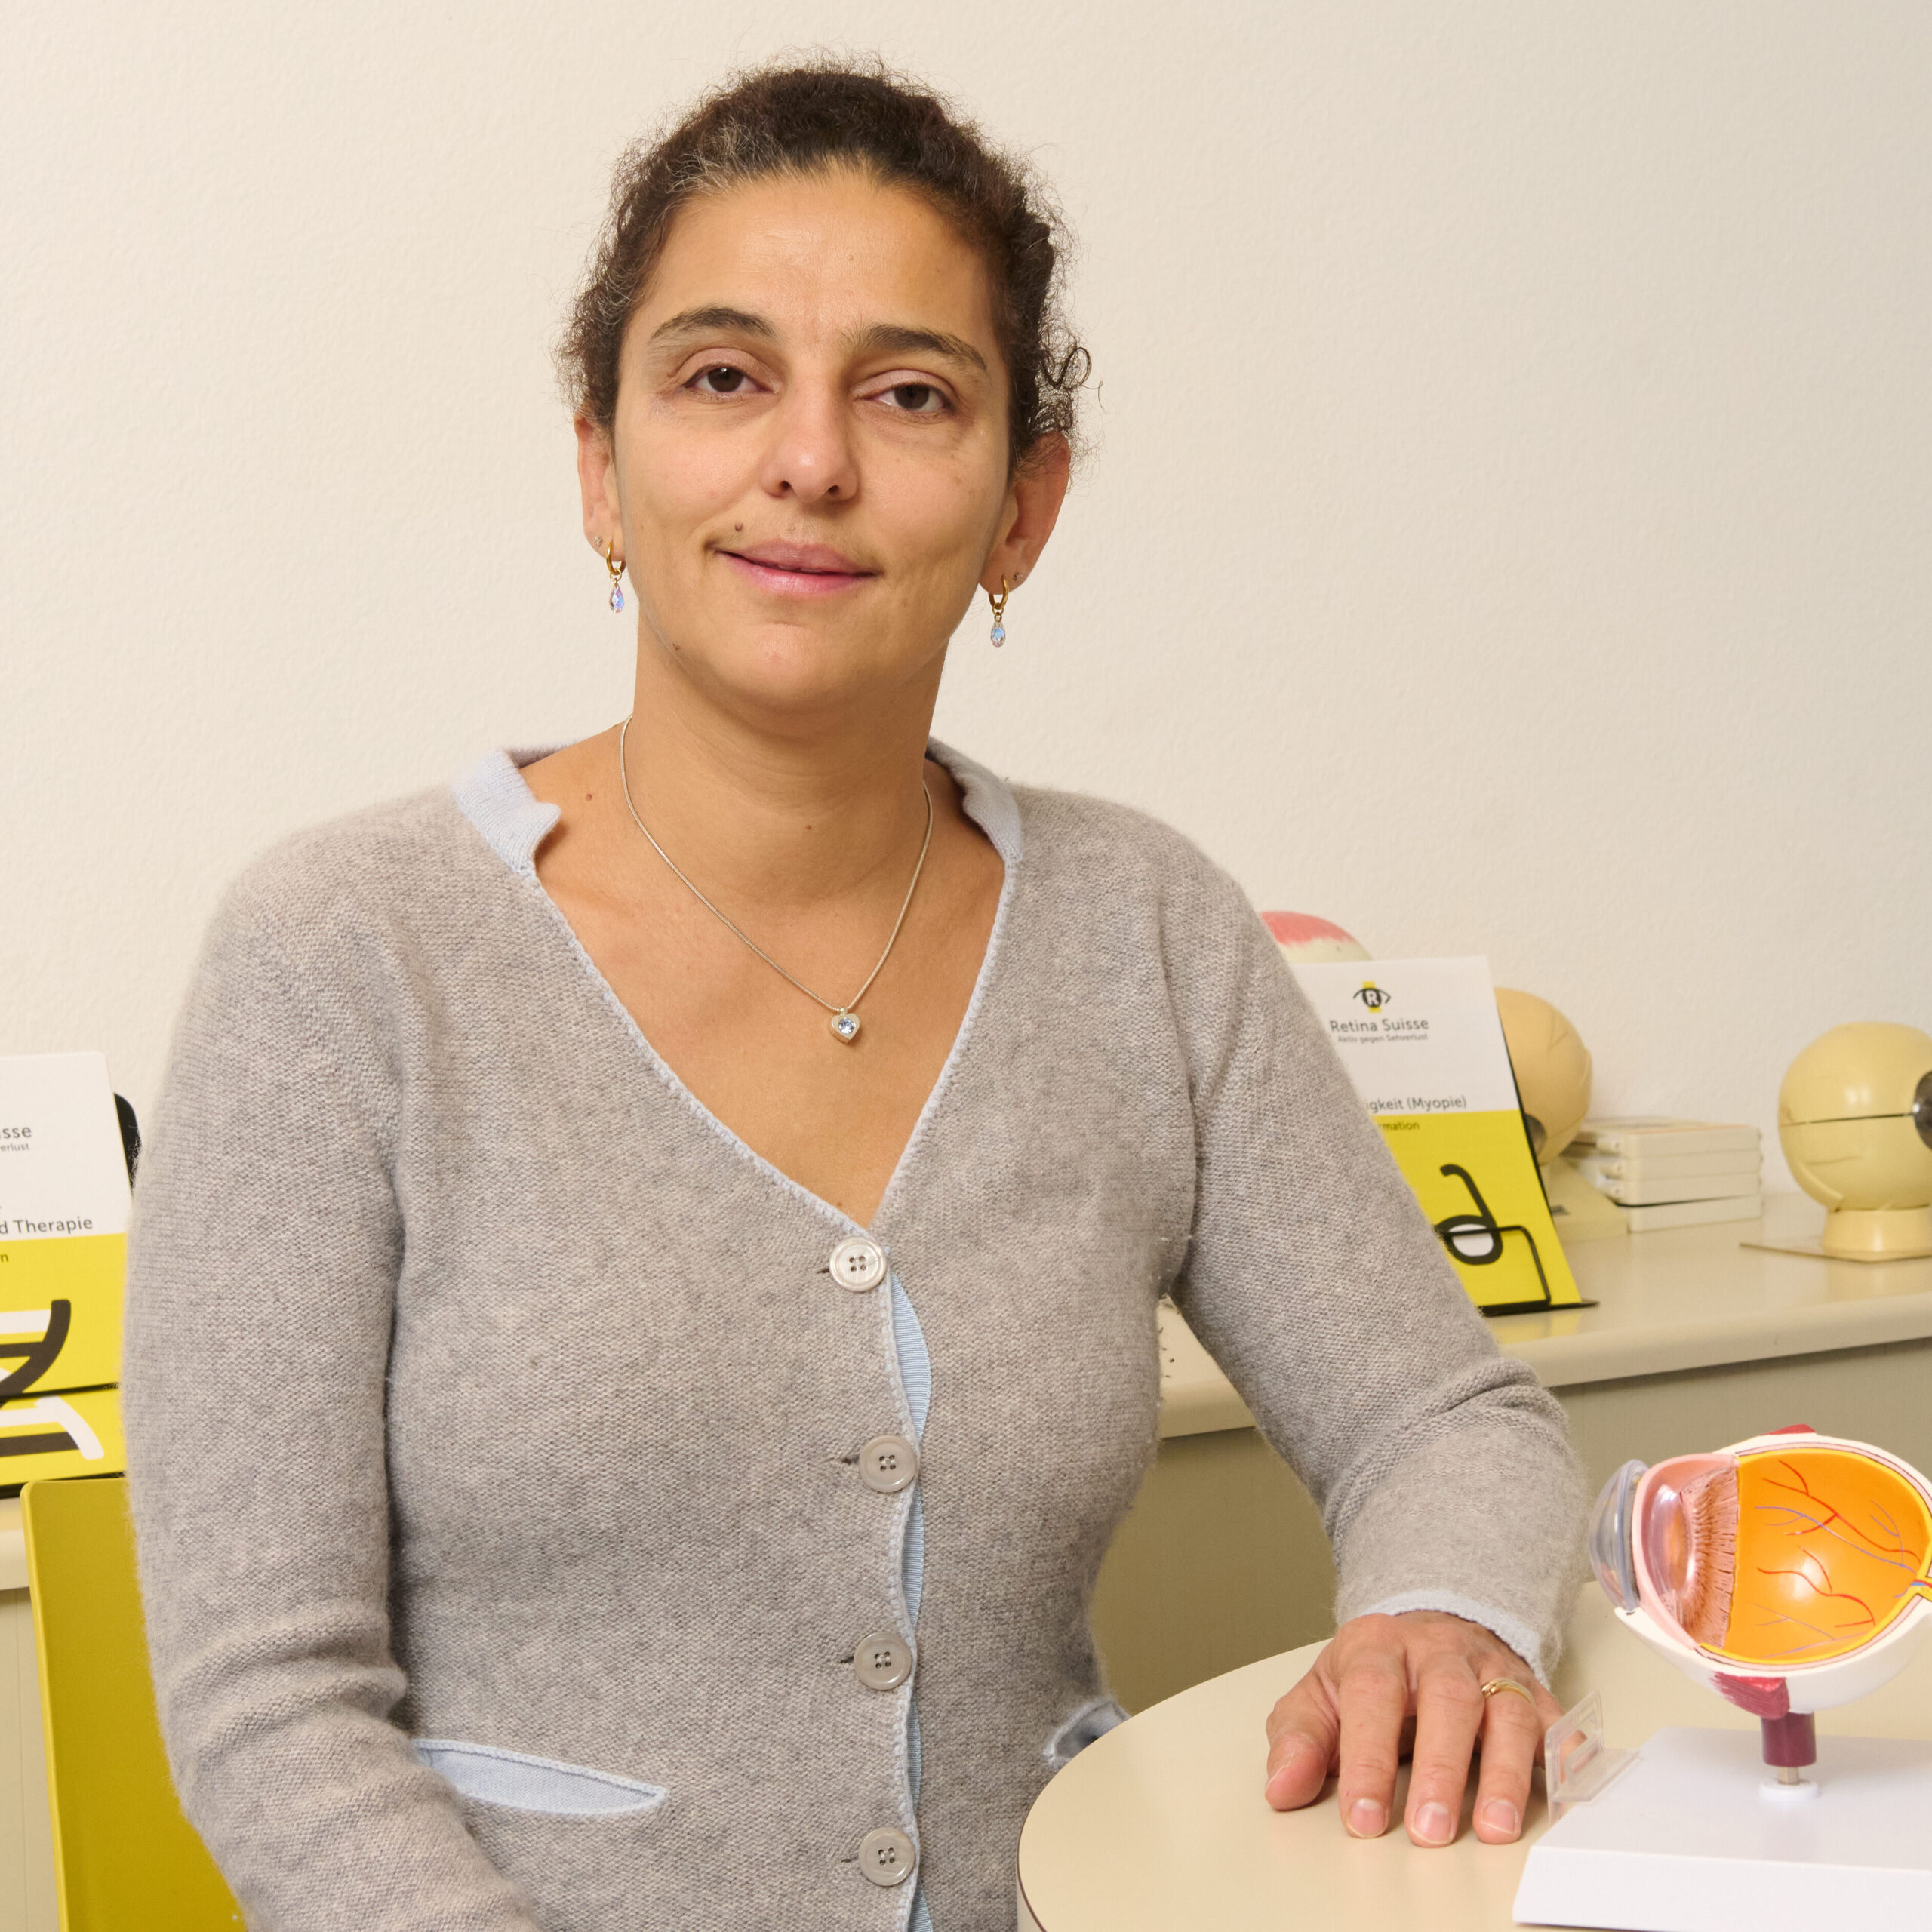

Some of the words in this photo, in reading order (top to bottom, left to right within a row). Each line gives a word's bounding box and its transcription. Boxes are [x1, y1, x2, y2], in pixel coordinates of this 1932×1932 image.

[1329, 1019, 1379, 1032] Retina
[1382, 1017, 1429, 1032] Suisse
[1359, 1036, 1384, 1044] gegen
[1407, 1095, 1466, 1112] (Myopie)
[13, 1215, 94, 1235] Therapie
